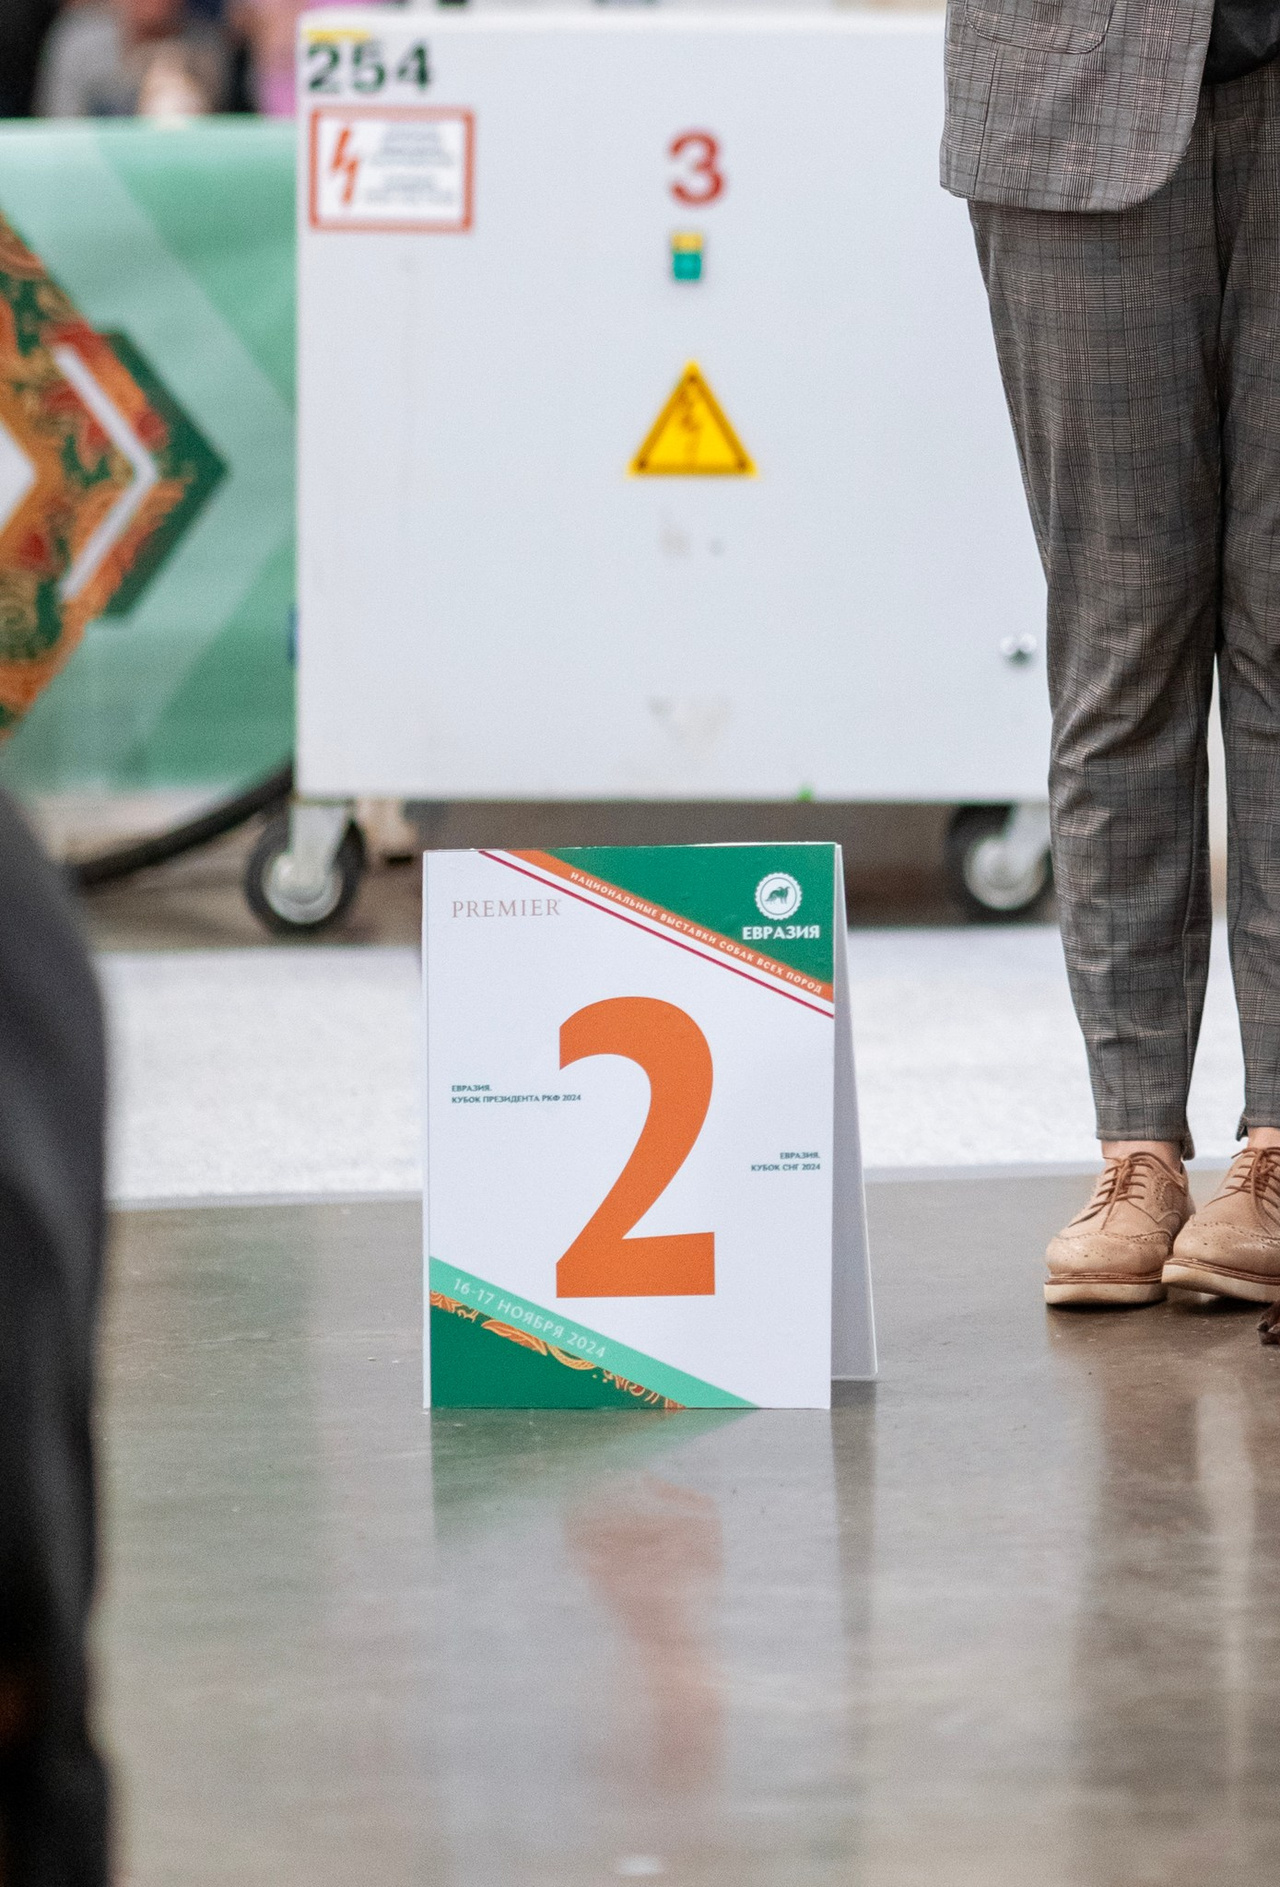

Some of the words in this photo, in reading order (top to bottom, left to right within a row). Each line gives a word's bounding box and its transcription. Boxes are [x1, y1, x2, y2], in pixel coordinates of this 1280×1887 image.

[306, 40, 434, 95] 254
[668, 129, 727, 207] 3
[452, 898, 560, 918] PREMIER
[570, 871, 657, 918] НАЦИОНАЛЬНЫЕ
[659, 912, 716, 944] ВЫСТАВКИ
[718, 940, 755, 962] СОБАК
[756, 957, 783, 976] ВСЕХ
[786, 970, 822, 995] ПОРОД
[742, 925, 820, 940] ЕВРАЗИЯ
[451, 1096, 481, 1104] КУБОК
[482, 1095, 540, 1103] ПРЕЗИДЕНТА
[541, 1094, 561, 1102] РКФ
[556, 996, 715, 1298] 2
[782, 1163, 799, 1171] СНГ
[453, 1278, 495, 1305] 16-17
[497, 1298, 564, 1338] НОЯБРЯ
[566, 1331, 606, 1358] 2024
